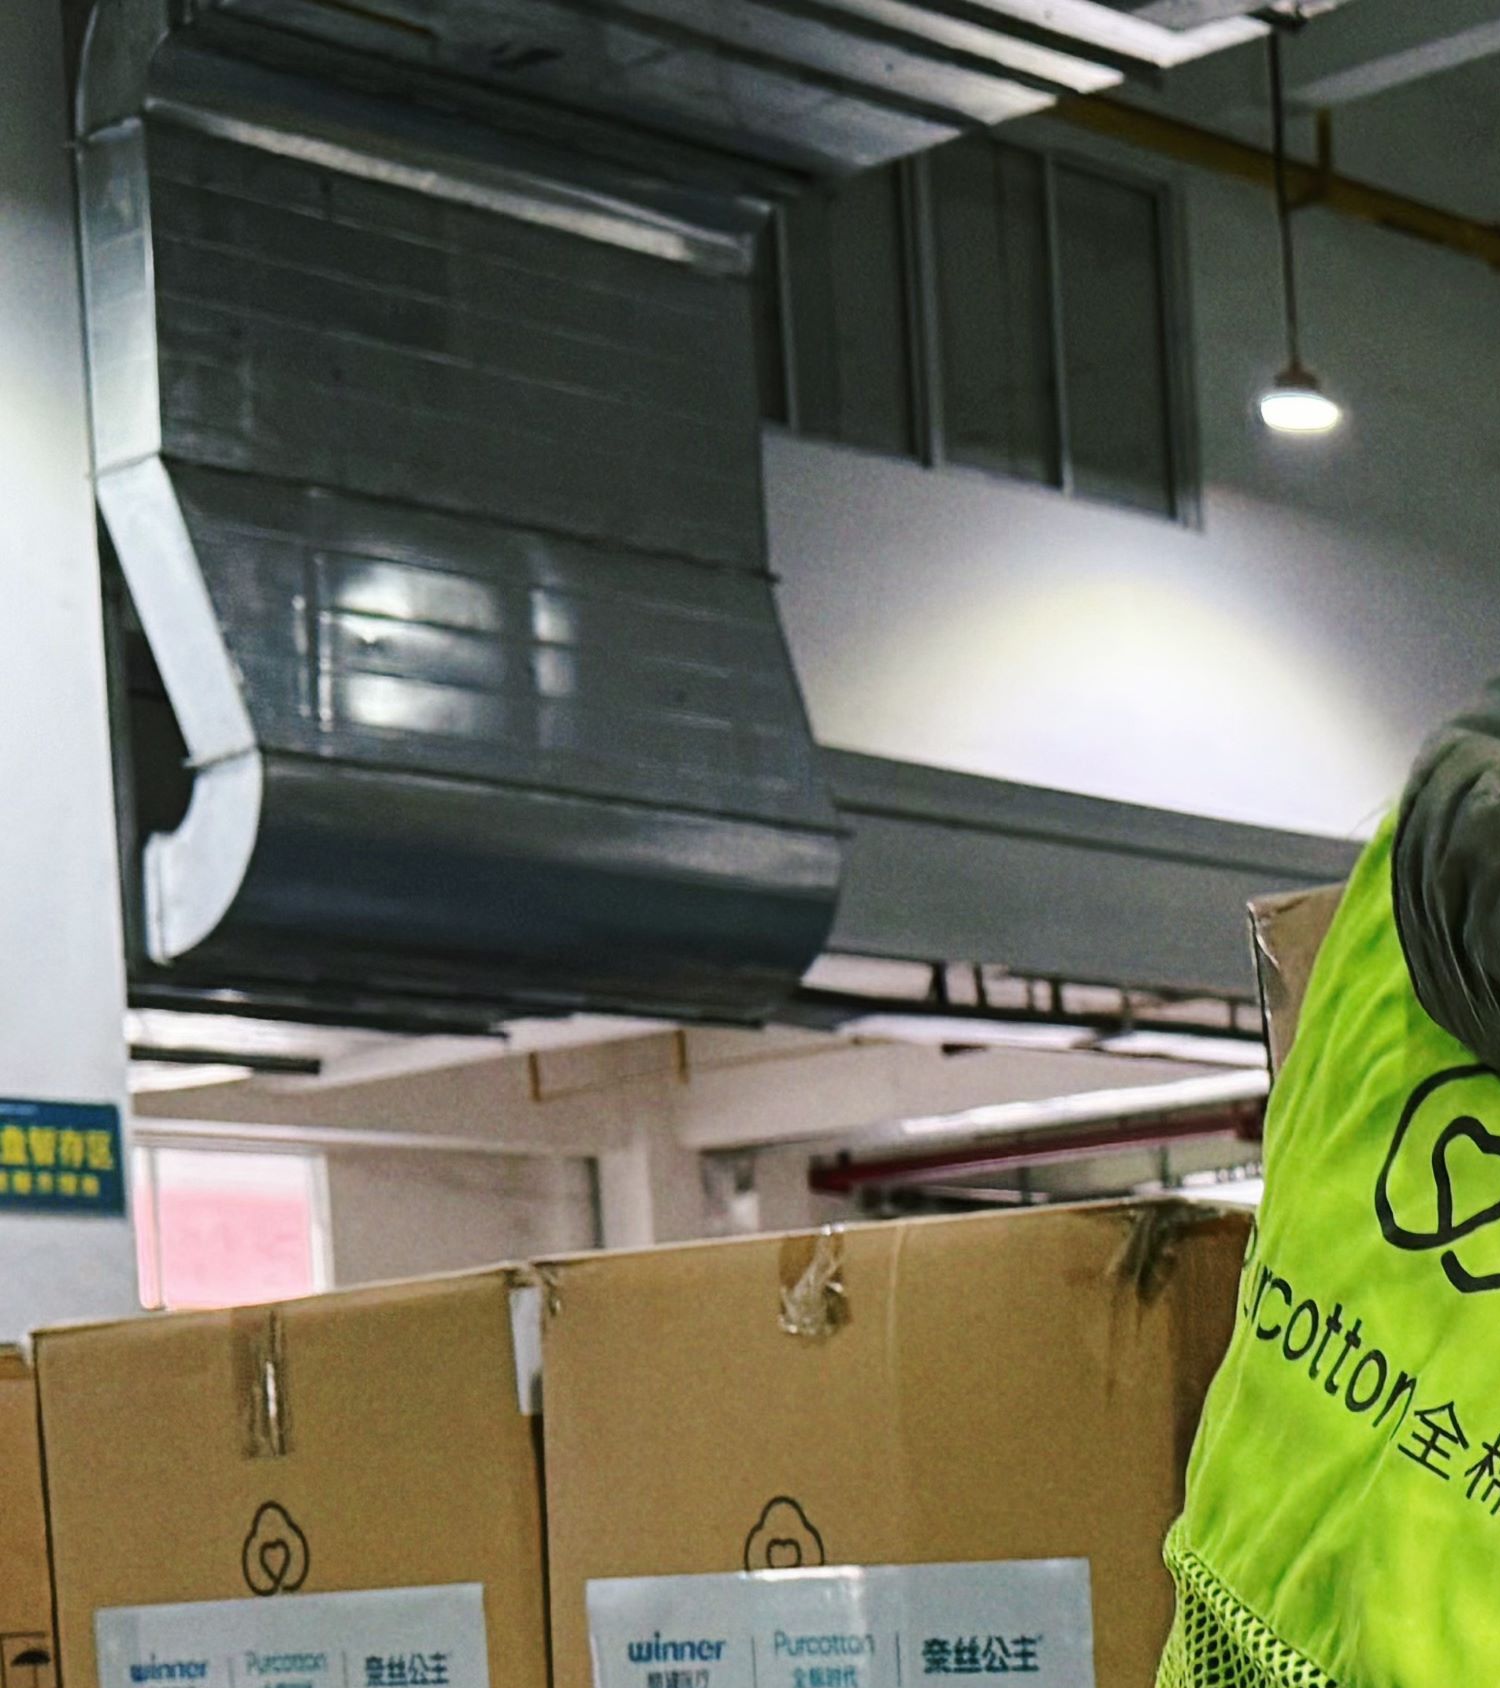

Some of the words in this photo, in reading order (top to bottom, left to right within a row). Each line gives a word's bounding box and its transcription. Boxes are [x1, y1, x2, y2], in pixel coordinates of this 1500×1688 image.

[1241, 1213, 1417, 1441] rcotton
[627, 1630, 726, 1664] winner
[921, 1635, 1042, 1675] 奈丝公主
